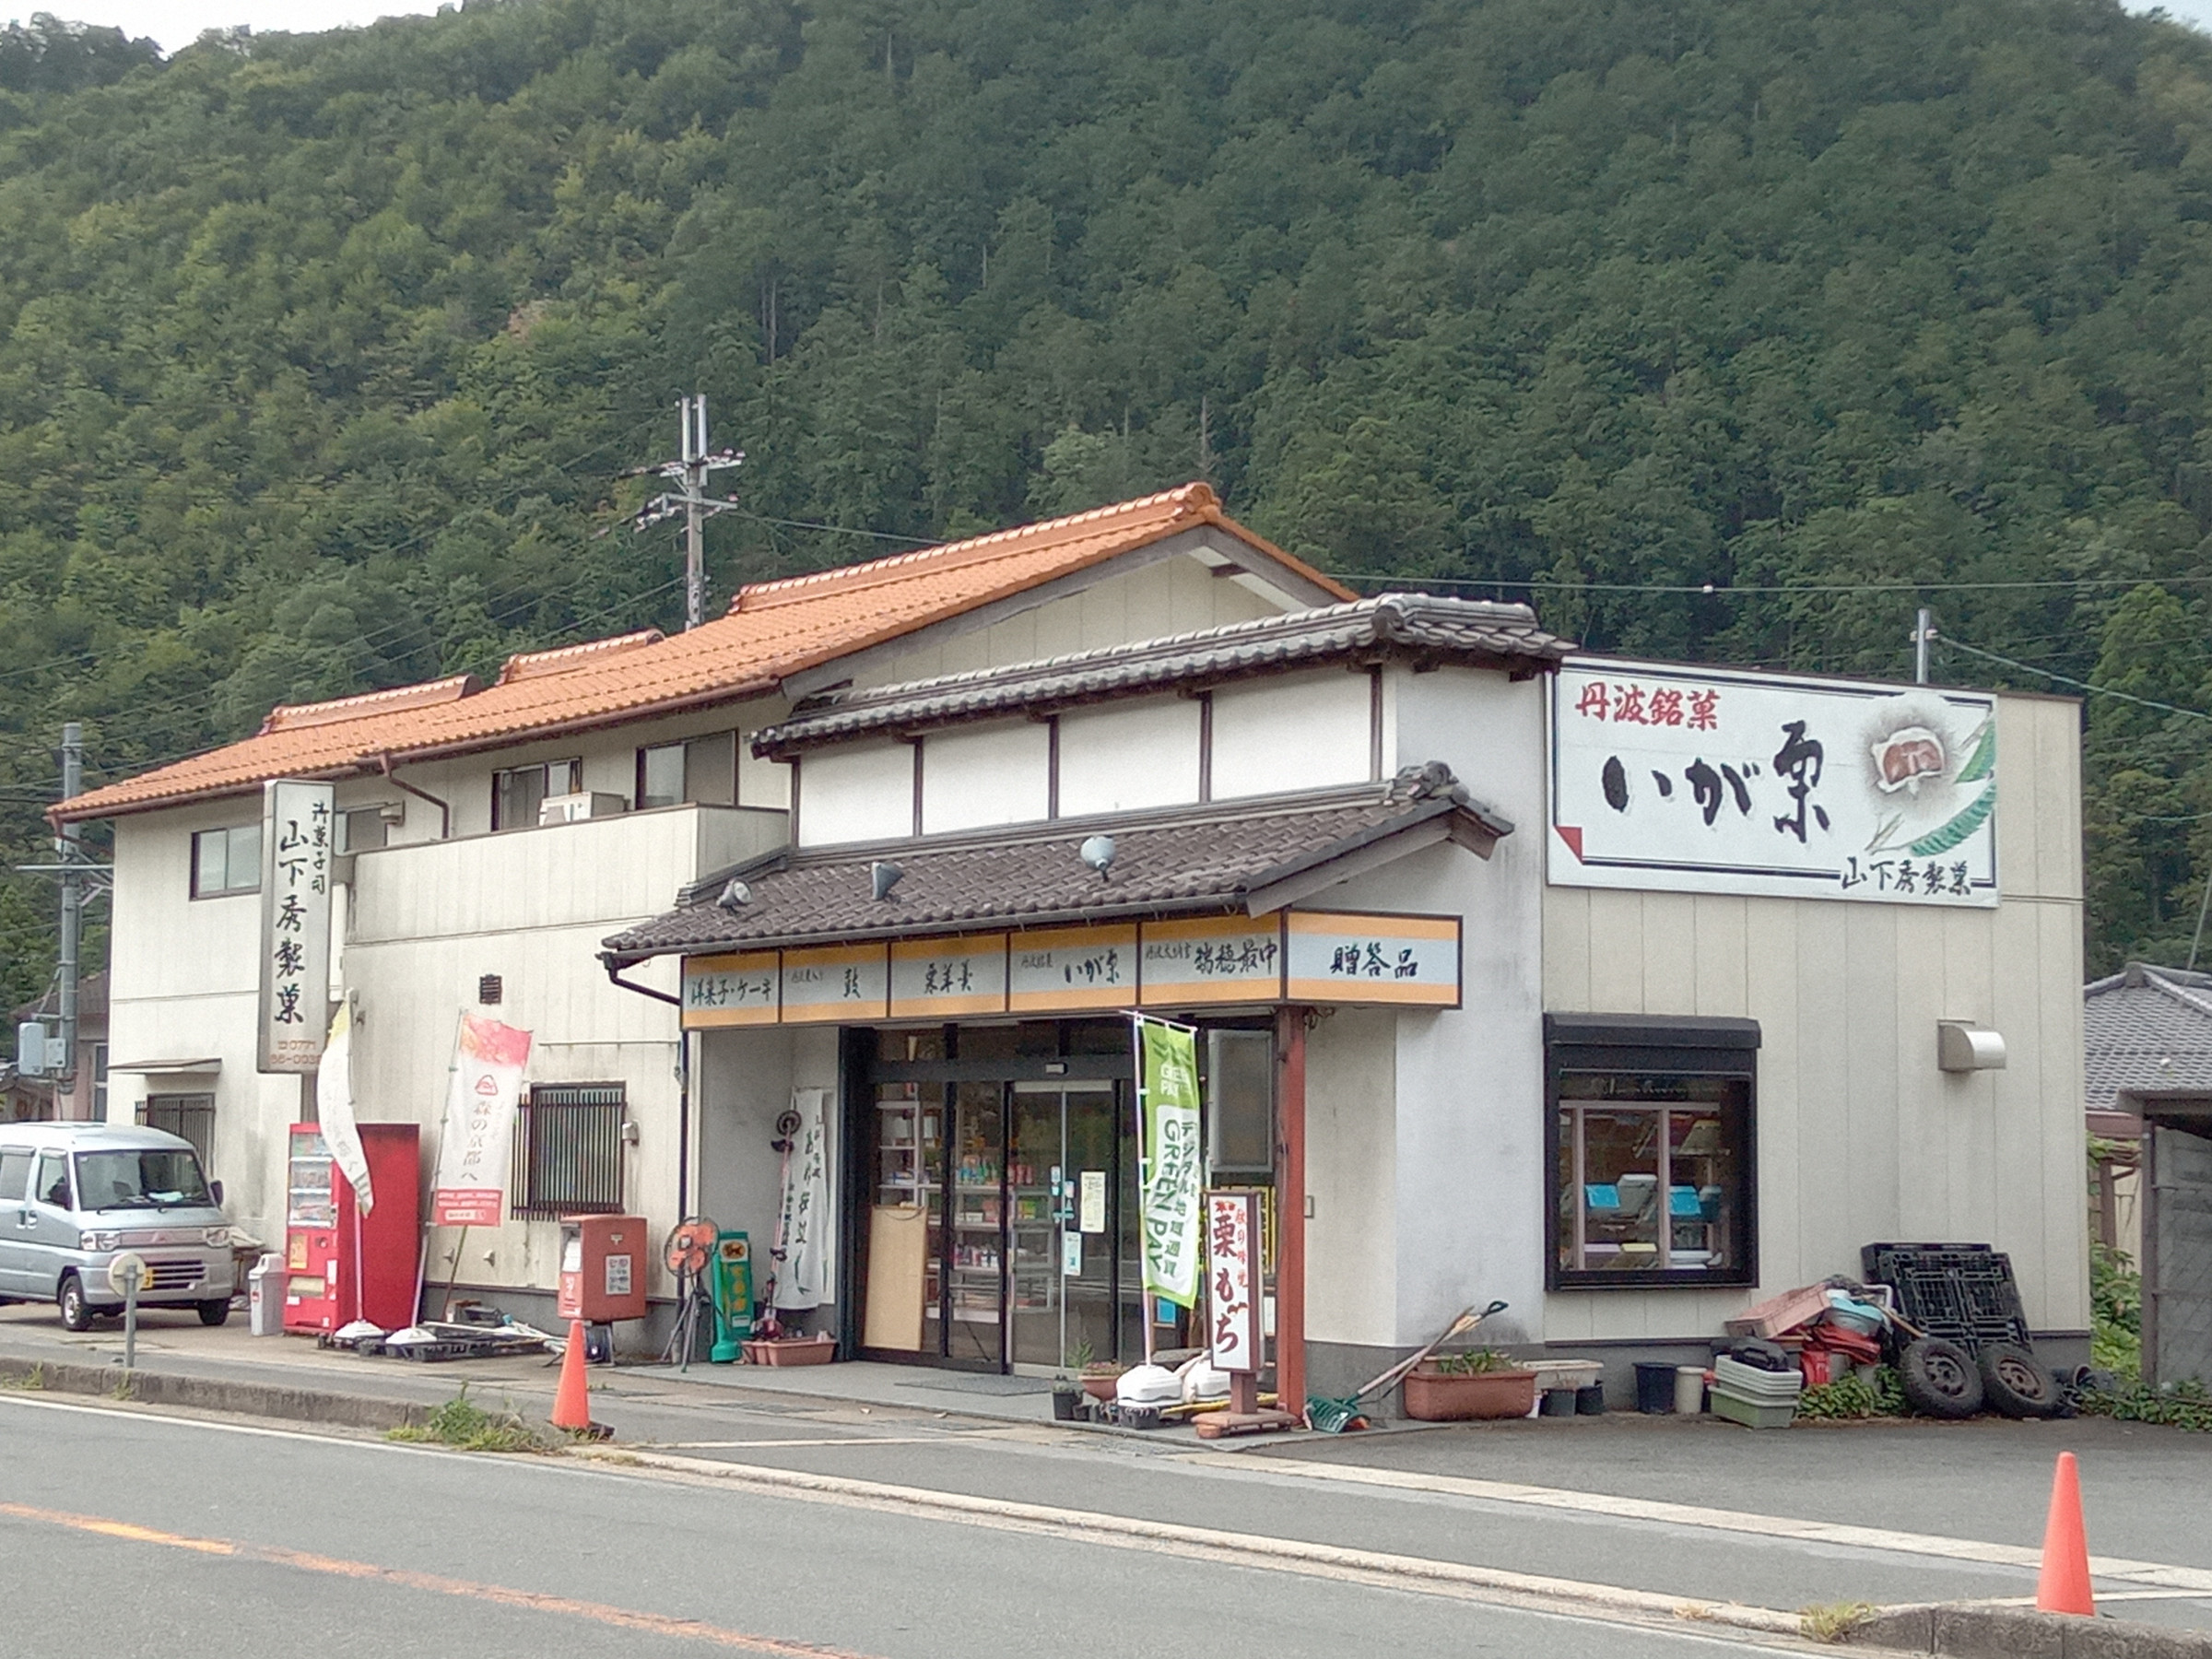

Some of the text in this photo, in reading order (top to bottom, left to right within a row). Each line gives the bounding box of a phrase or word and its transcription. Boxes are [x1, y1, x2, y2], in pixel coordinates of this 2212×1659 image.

[1575, 682, 1721, 731] 丹波銘菓
[1601, 719, 1830, 842] いが栗
[1841, 856, 1971, 896] 山下秀製菓
[274, 819, 309, 1024] 山下秀製菓
[1065, 947, 1120, 984] いが栗
[1329, 941, 1418, 979] 贈答品
[1213, 1213, 1239, 1354] 栗もち
